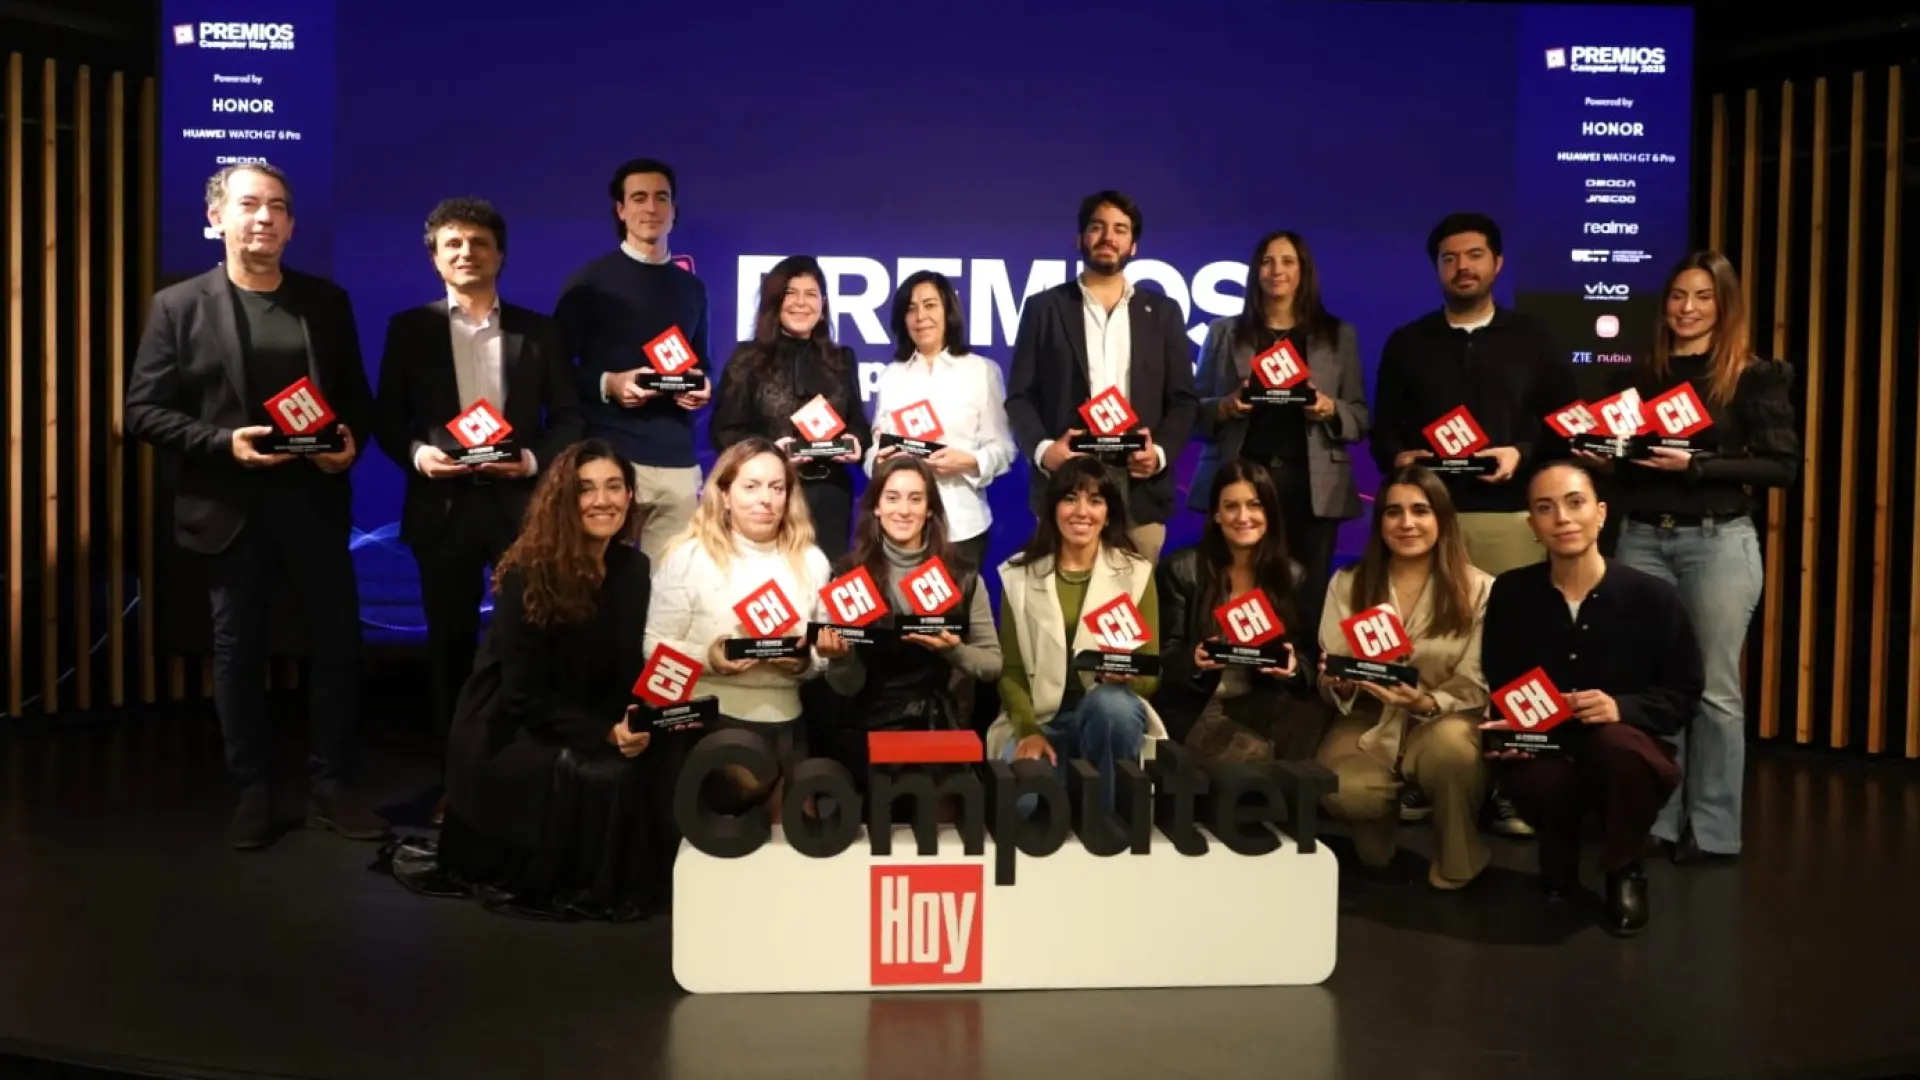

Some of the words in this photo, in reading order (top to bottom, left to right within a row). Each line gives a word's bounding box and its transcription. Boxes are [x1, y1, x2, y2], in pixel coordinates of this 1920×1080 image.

[200, 22, 294, 40] PREMIOS
[1571, 46, 1666, 64] PREMIOS
[214, 73, 250, 83] Powered
[251, 74, 262, 85] by
[212, 98, 274, 113] HONOR
[1584, 97, 1621, 107] Powered
[1621, 97, 1633, 108] by
[182, 129, 226, 138] HUAWEI
[228, 129, 262, 139] WATCH
[264, 130, 276, 139] GT
[286, 131, 301, 140] Pro
[1582, 122, 1644, 136] HONOR
[1557, 151, 1601, 161] HUAWEI
[1603, 152, 1637, 162] WATCH
[1638, 153, 1651, 162] GT
[1660, 153, 1676, 162] Pro
[1583, 220, 1639, 234] realme
[1584, 281, 1630, 294] vivo
[653, 334, 690, 371] CH
[1261, 347, 1300, 386] CH
[1572, 352, 1592, 363] ZTE
[1597, 352, 1632, 363] nubia
[277, 387, 324, 432] CH
[457, 405, 501, 446] CH
[901, 404, 936, 438] CH
[1090, 393, 1128, 433] CH
[1556, 404, 1598, 436] CH
[1601, 394, 1646, 437] CH
[1655, 391, 1701, 435] CH
[1434, 414, 1478, 456] CH
[831, 575, 876, 623] CH
[911, 566, 953, 612] CH
[746, 587, 790, 636] CH
[1097, 603, 1141, 648] CH
[1227, 598, 1271, 643] CH
[1353, 612, 1400, 658] CH
[646, 655, 693, 702] CH
[1504, 678, 1559, 728] CH
[674, 729, 1339, 886] Computer
[880, 875, 976, 975] Hoy
